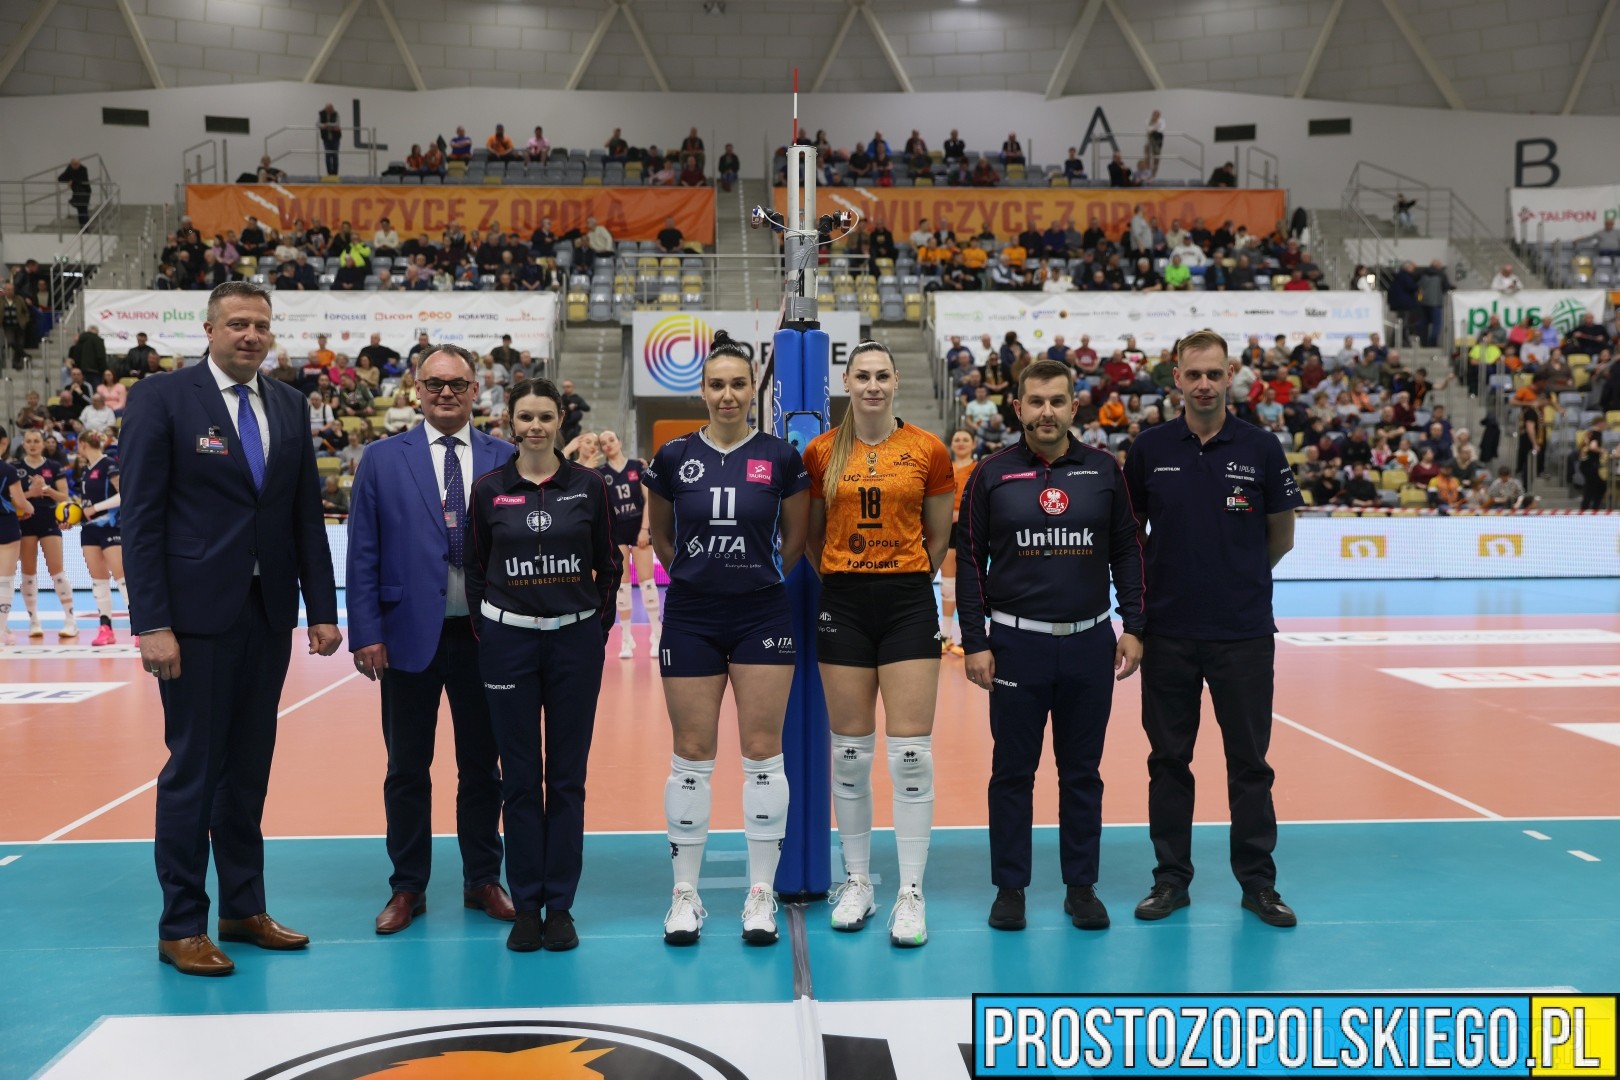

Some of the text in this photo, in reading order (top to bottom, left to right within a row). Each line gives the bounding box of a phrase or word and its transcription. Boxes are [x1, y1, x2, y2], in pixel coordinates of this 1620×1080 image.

[1078, 106, 1119, 155] A
[1515, 138, 1560, 188] B
[277, 198, 466, 232] WILCZYCE
[478, 199, 499, 231] Z
[860, 200, 1046, 234] WILCZYCE
[116, 308, 195, 322] TAURON plus
[748, 473, 772, 481] TAURON
[616, 484, 631, 499] 13
[709, 487, 736, 519] 11
[858, 487, 881, 519] 18
[707, 536, 746, 553] ITA
[868, 540, 900, 548] OPOLE
[1016, 527, 1094, 547] Unilink
[708, 552, 746, 560] TOOLS
[852, 559, 899, 569] OPOLSKIE
[778, 637, 793, 646] ITA
[662, 649, 672, 666] 11
